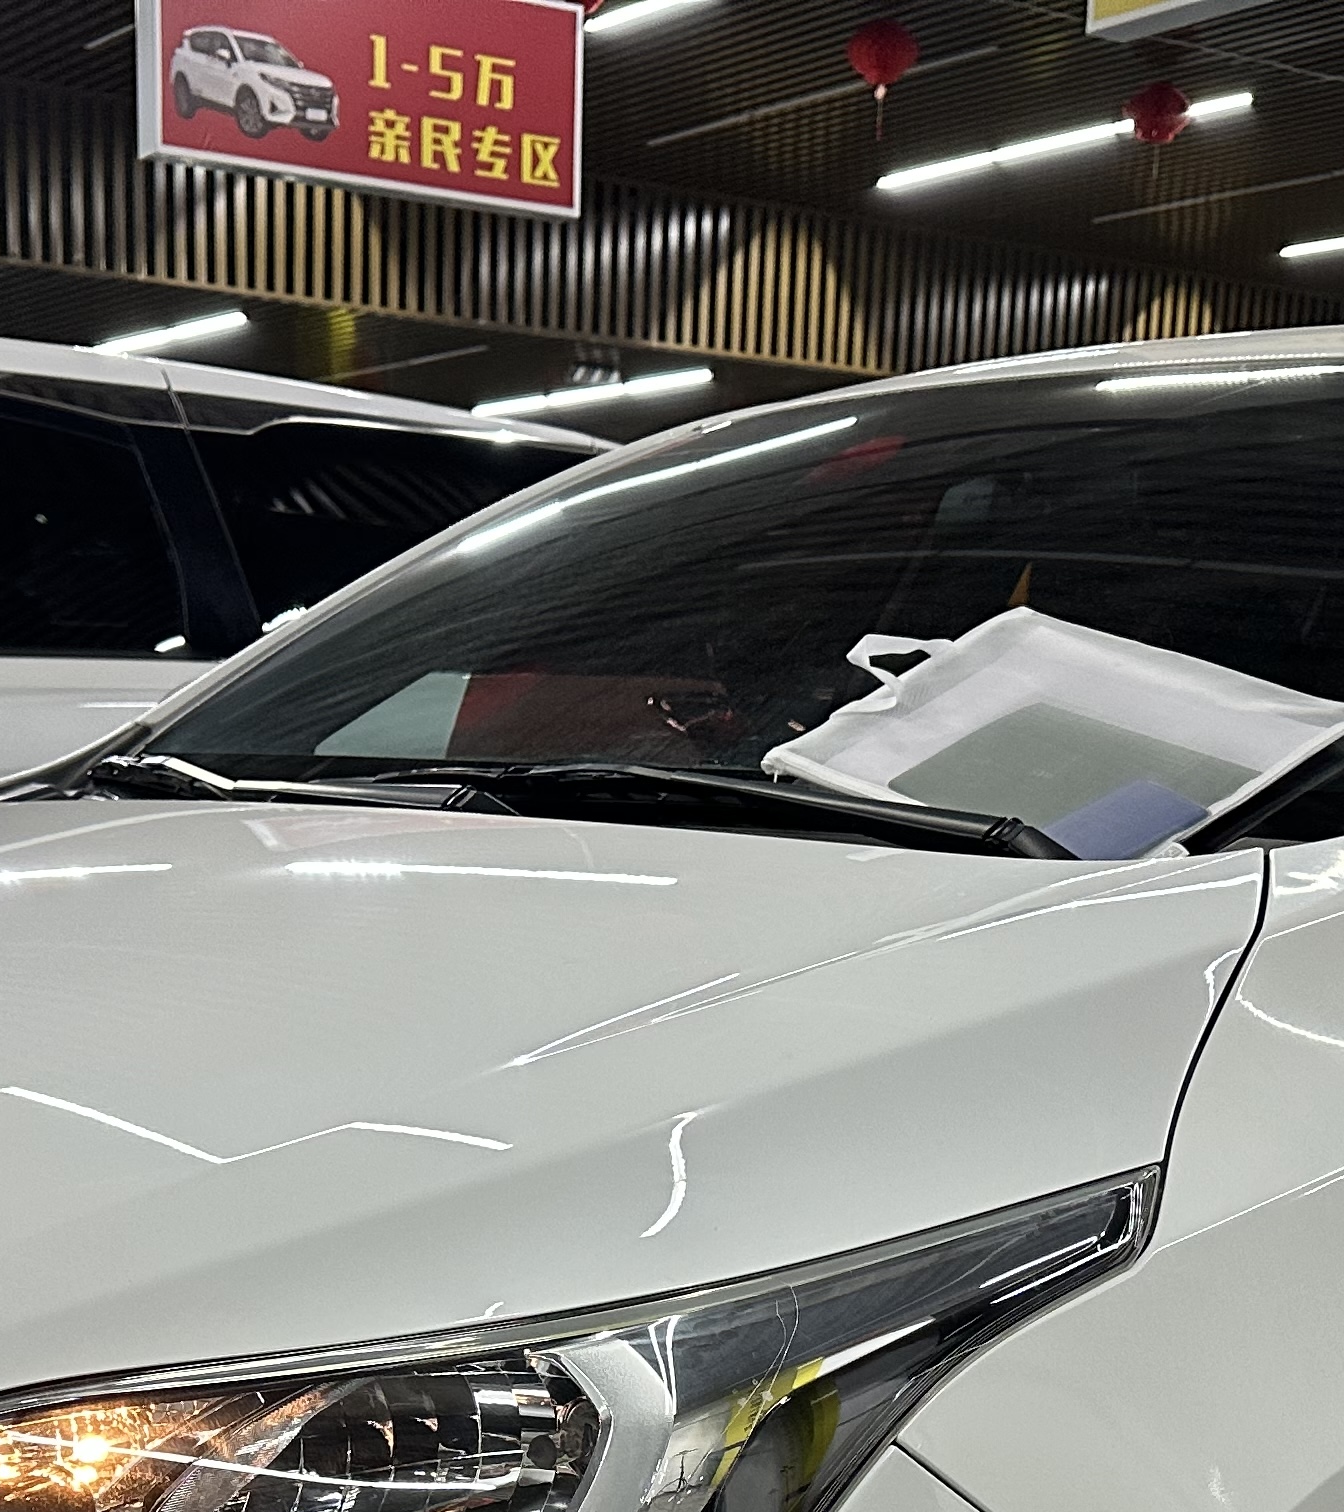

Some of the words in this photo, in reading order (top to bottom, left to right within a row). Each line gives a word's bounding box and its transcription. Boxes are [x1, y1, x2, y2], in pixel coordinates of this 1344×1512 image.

[368, 34, 516, 110] 1-5万
[368, 109, 561, 187] 亲民专区
